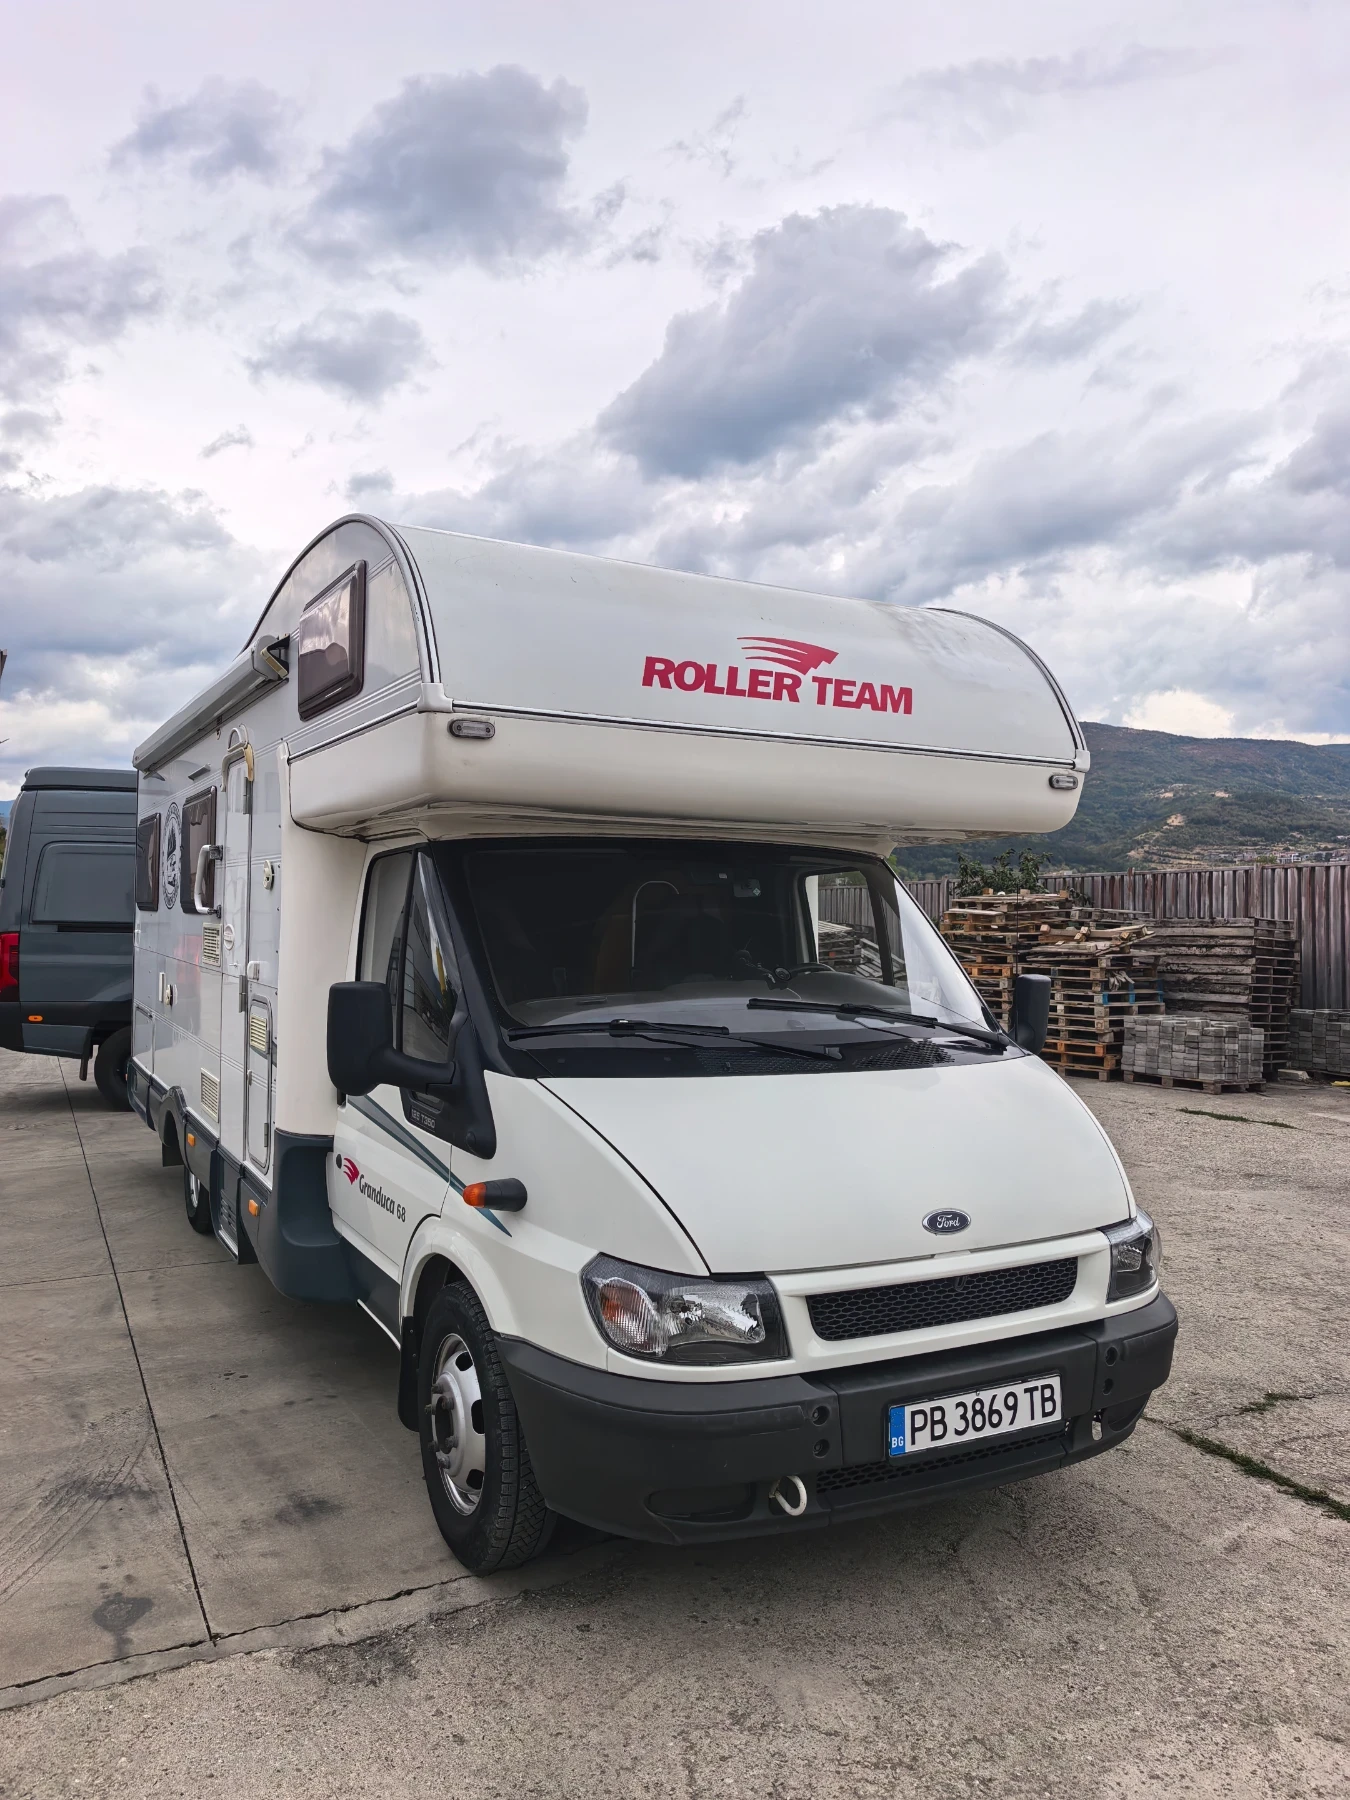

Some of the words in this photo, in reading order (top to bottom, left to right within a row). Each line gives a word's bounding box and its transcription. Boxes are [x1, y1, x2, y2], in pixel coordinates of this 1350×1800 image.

[641, 655, 802, 703] ROLLER
[811, 675, 913, 715] TEAM
[421, 1114, 436, 1129] T350
[359, 1174, 395, 1215] Granduca
[396, 1203, 406, 1223] 68
[936, 1214, 961, 1229] Ford
[910, 1405, 947, 1446] PB
[954, 1391, 1018, 1436] 3869
[1023, 1383, 1057, 1421] TB
[891, 1436, 904, 1449] BG
